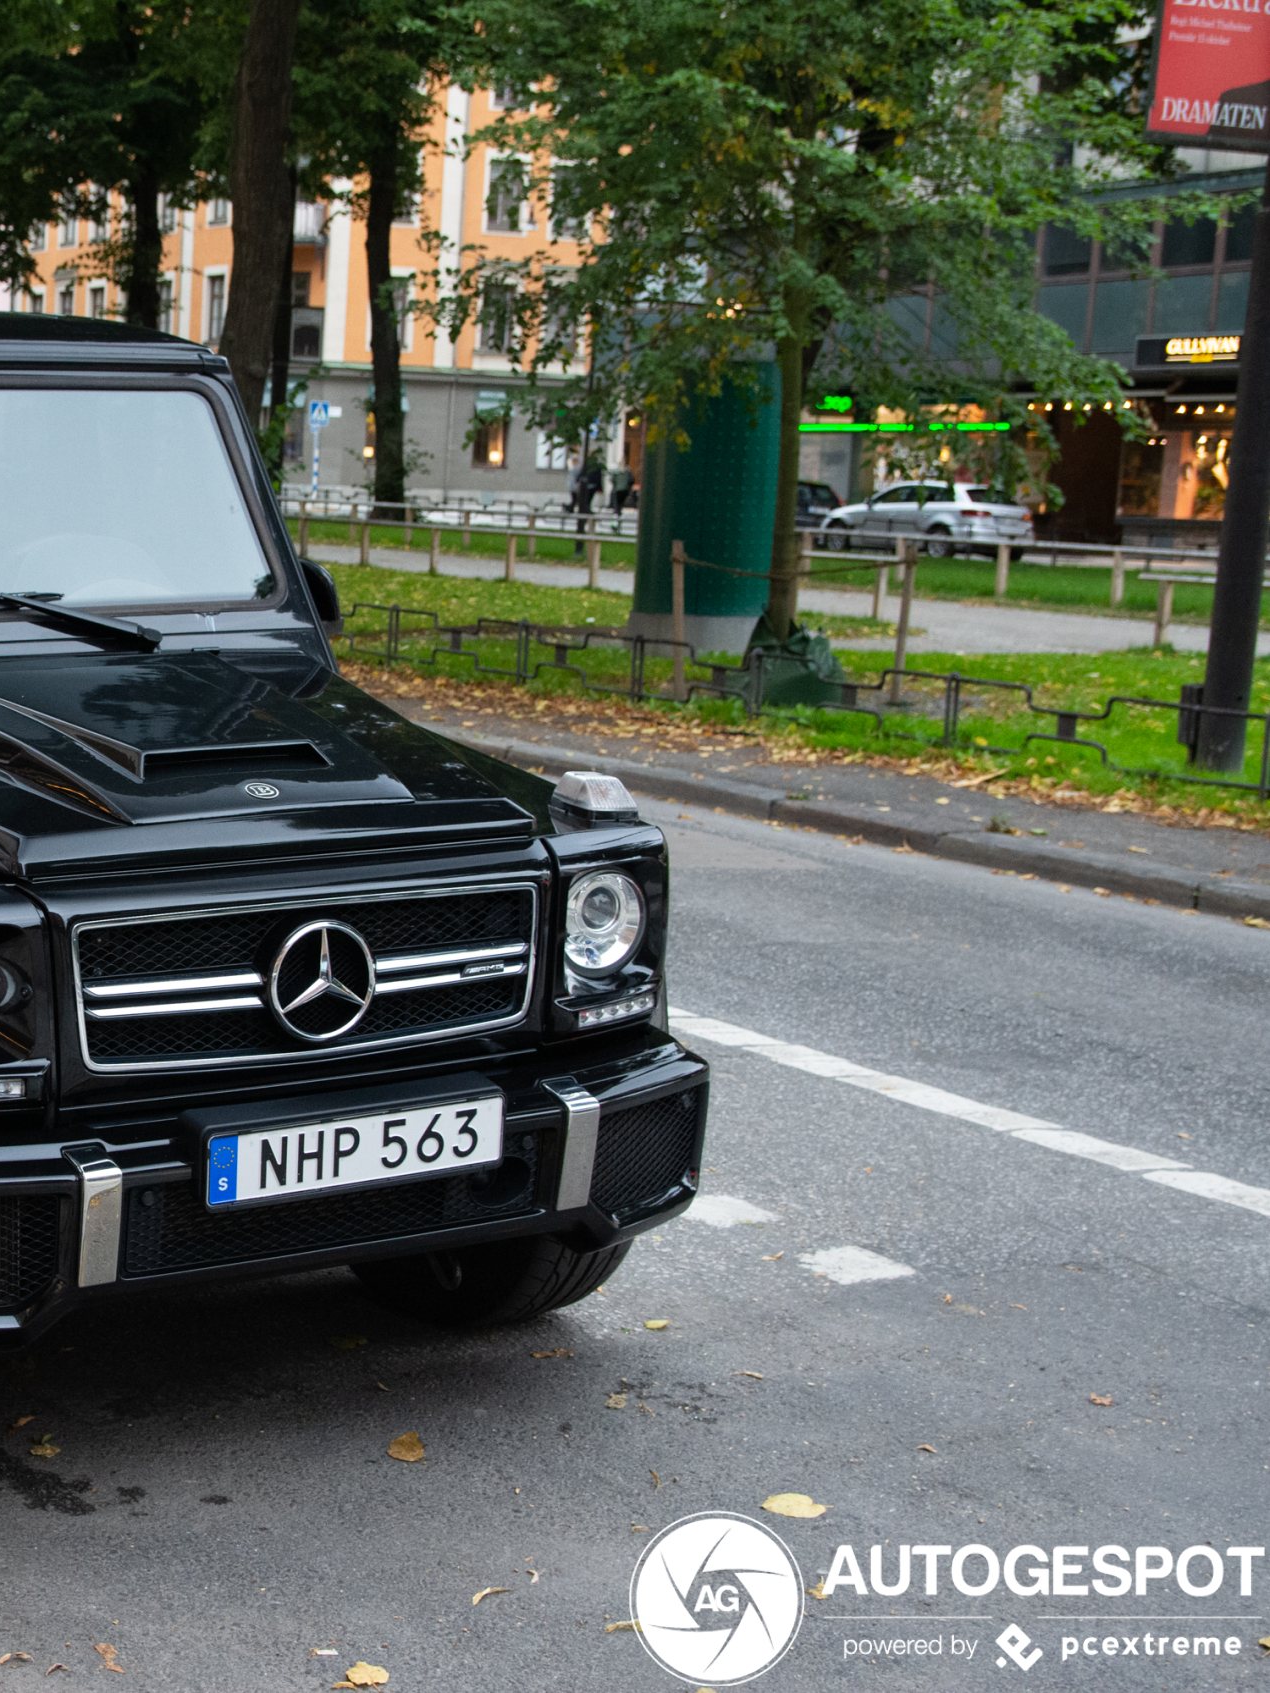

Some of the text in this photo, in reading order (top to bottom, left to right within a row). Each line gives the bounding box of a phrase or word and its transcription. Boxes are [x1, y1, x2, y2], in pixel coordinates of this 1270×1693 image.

[1160, 97, 1267, 130] DRAMATEN
[259, 1108, 478, 1190] NHP 563
[218, 1177, 228, 1191] S
